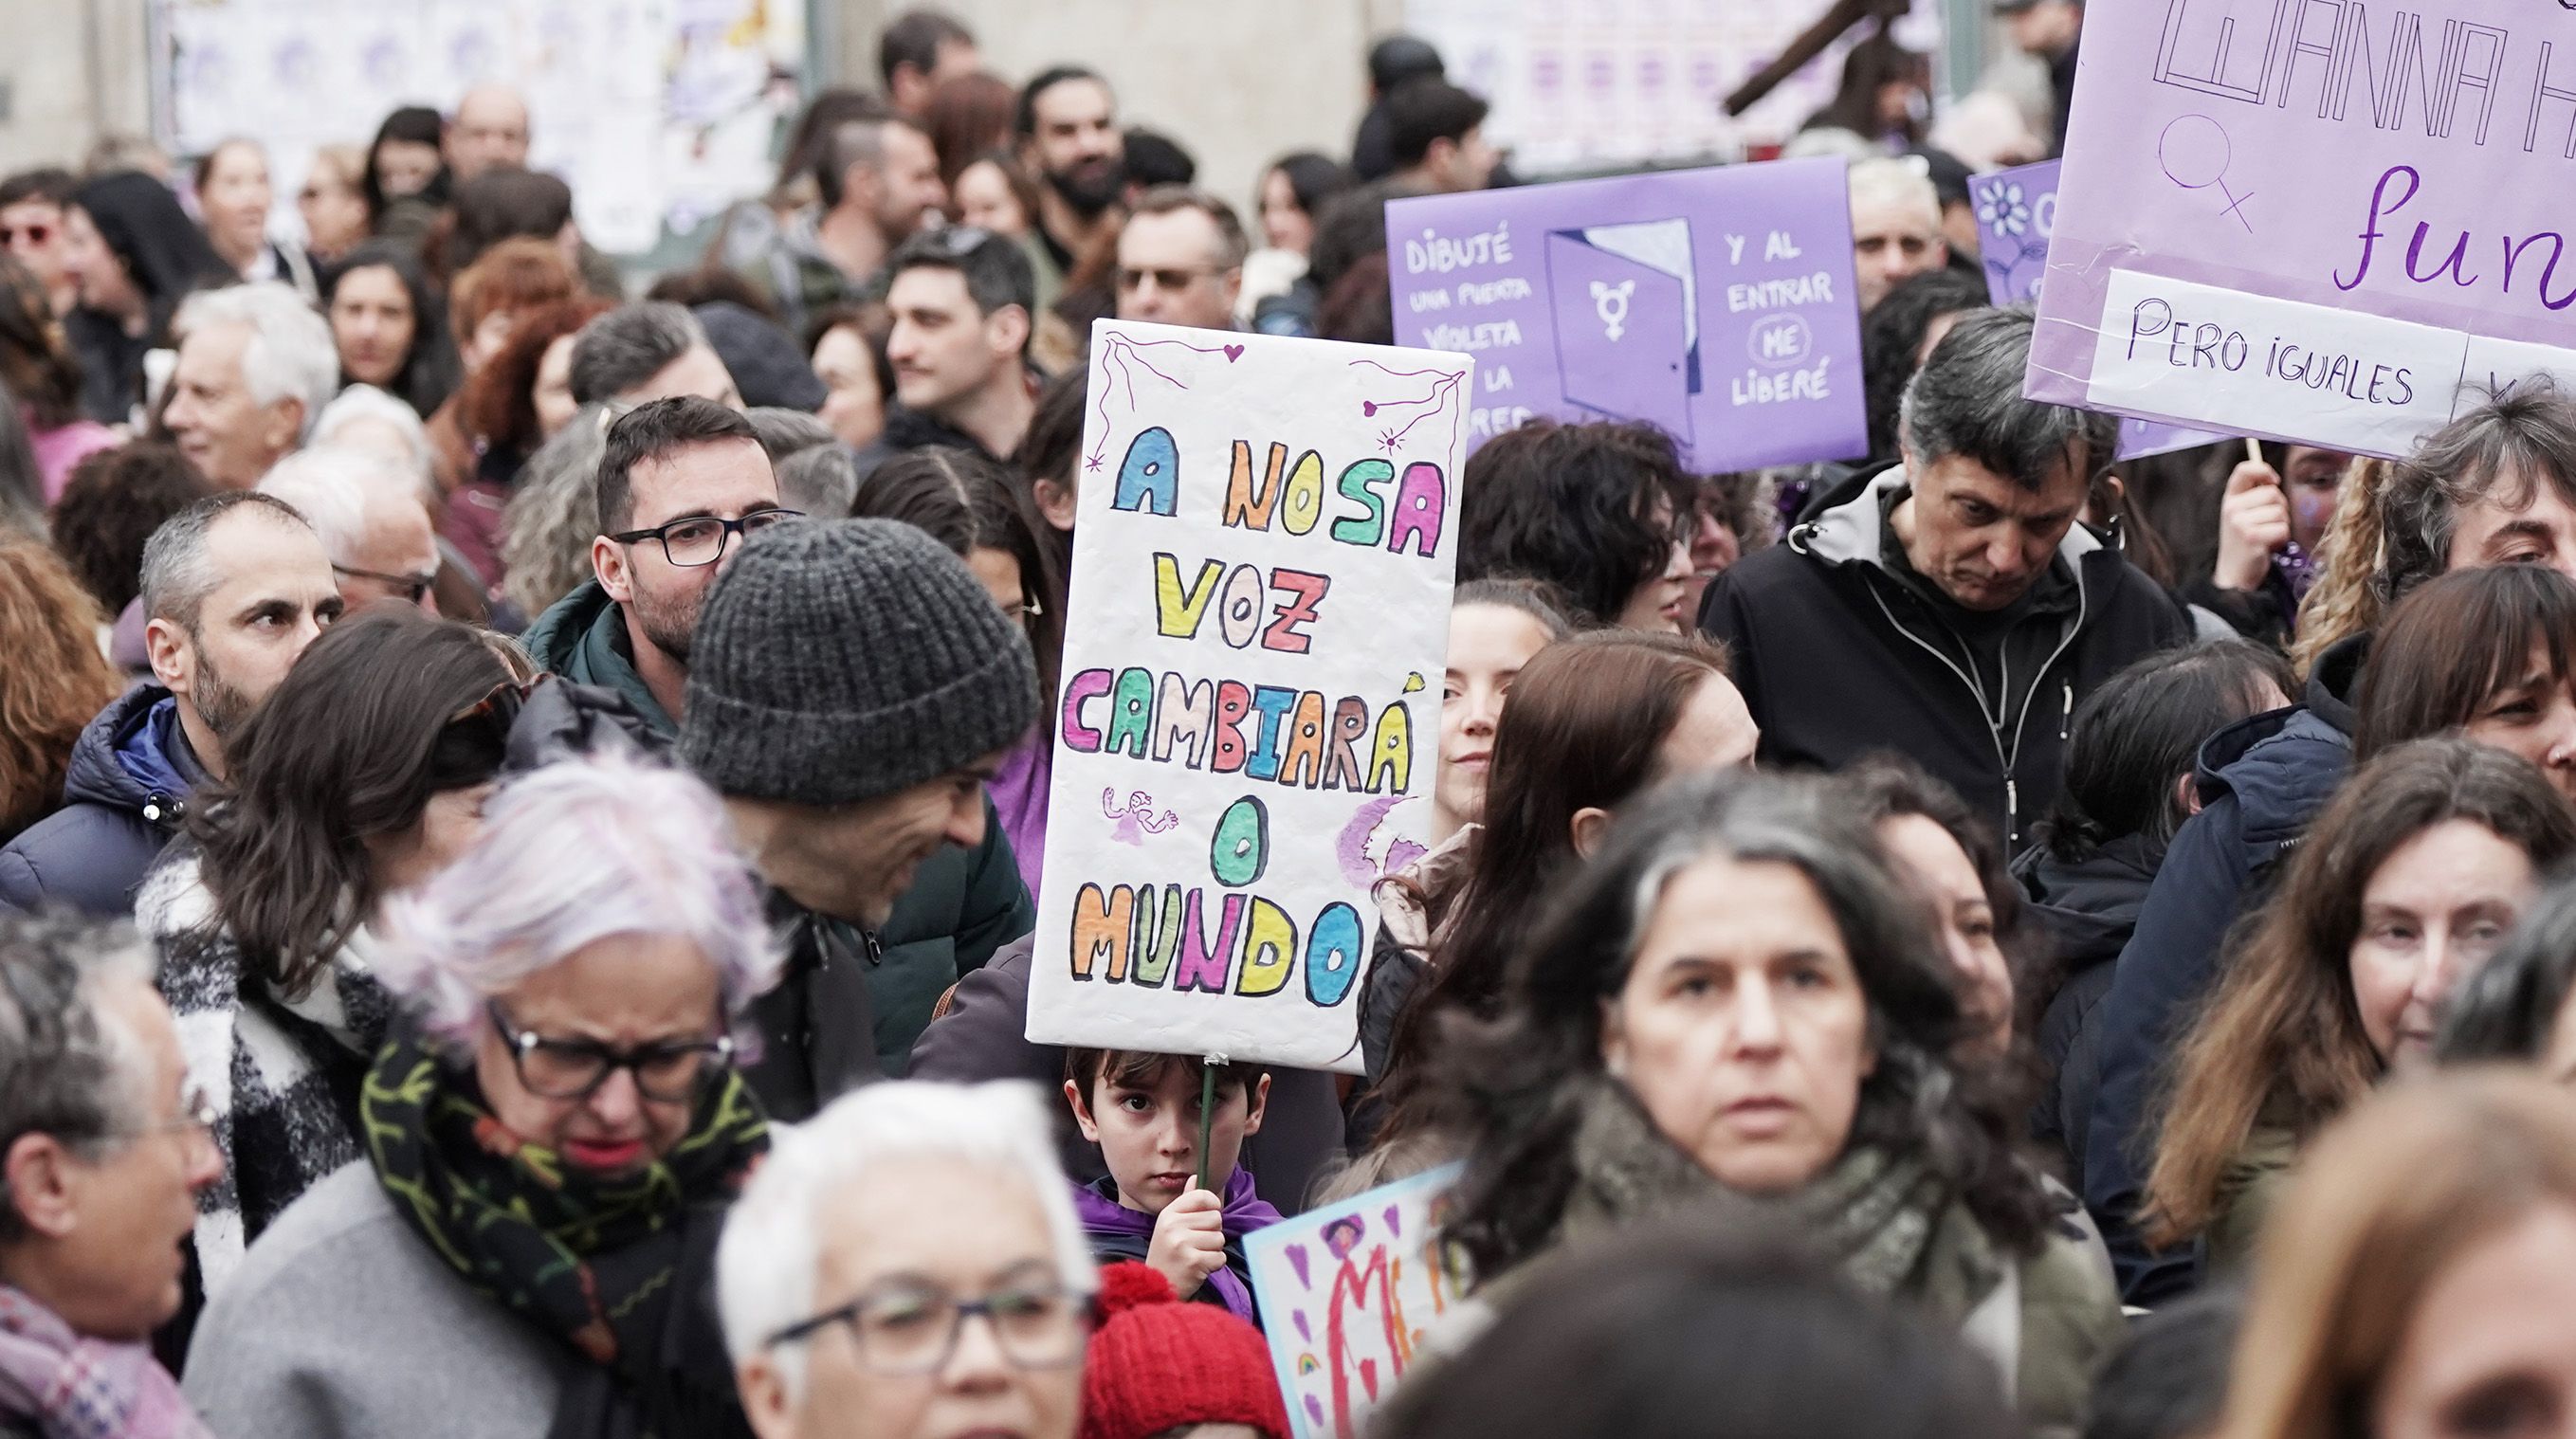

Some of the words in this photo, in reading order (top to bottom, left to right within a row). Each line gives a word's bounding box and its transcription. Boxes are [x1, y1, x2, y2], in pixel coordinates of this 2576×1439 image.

[2154, 0, 2508, 145] WANNA
[1724, 232, 1745, 266] Y
[1764, 229, 1802, 263] AL
[1727, 271, 1834, 314] ENTRAR
[1409, 288, 1452, 313] UNA
[1457, 277, 1532, 306] PUERTA
[1763, 323, 1800, 358] ME
[1484, 364, 1514, 394] LA
[1110, 426, 1179, 517] A
[1222, 439, 1446, 557] NOSA
[1153, 552, 1331, 654] VOZ
[1062, 666, 1426, 794] CAMBIARÁ
[1210, 794, 1270, 887] O
[1070, 883, 1363, 1008] MUNDO
